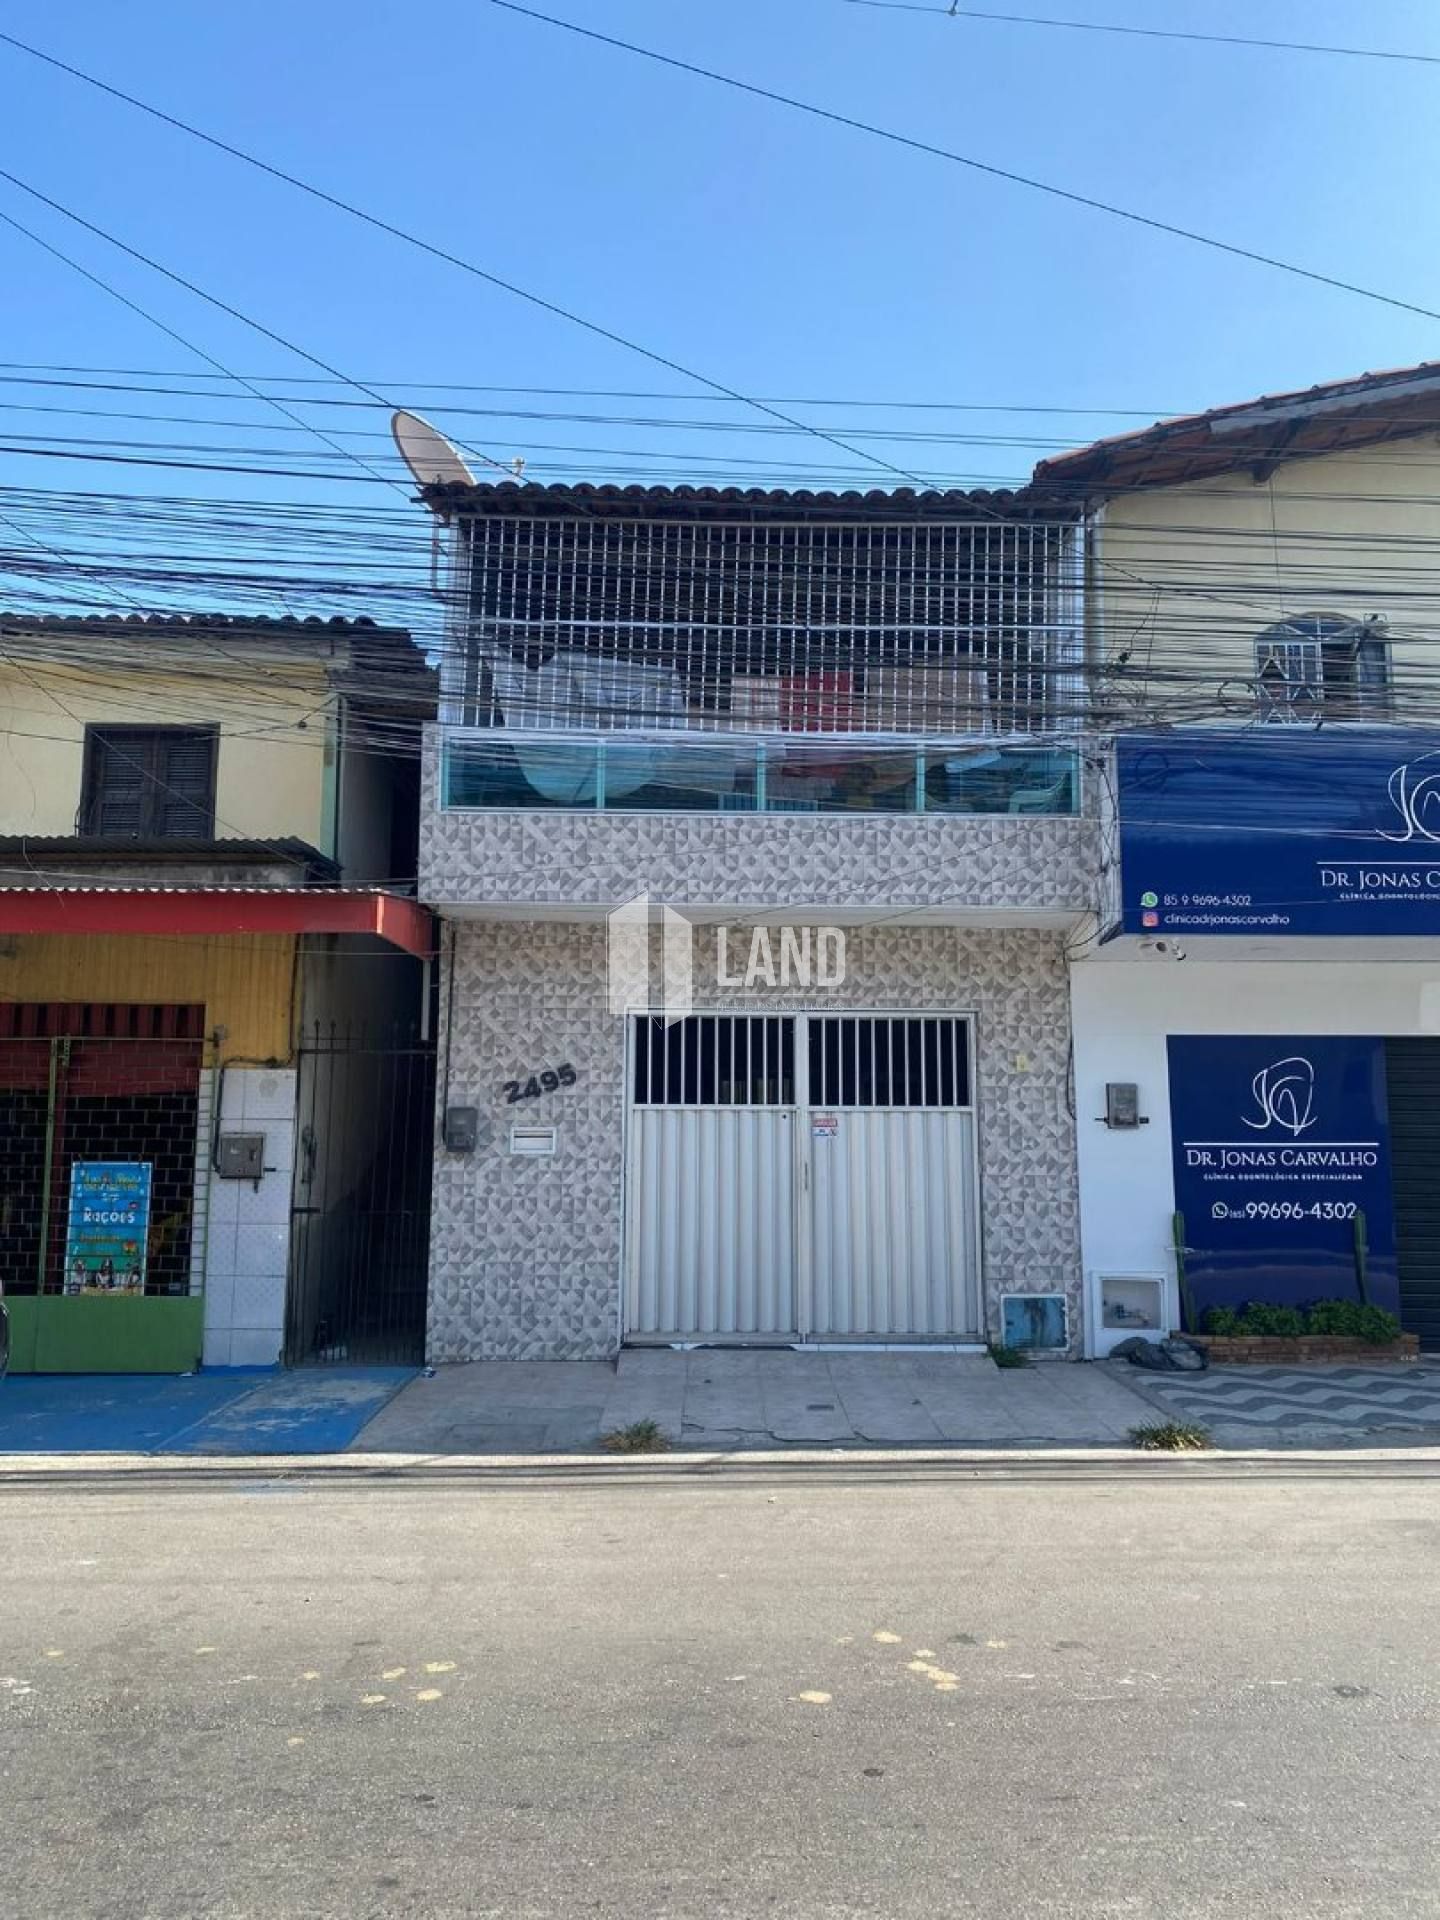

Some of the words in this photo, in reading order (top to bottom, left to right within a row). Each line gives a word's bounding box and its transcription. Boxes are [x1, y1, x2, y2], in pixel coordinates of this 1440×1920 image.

[1321, 870, 1354, 887] DR.
[1359, 870, 1422, 891] JONAS
[1163, 894, 1178, 906] 85
[1182, 894, 1190, 906] 9
[1192, 893, 1252, 907] 9696-4302
[502, 1062, 577, 1104] 2495
[1186, 1150, 1217, 1166] DR.
[1220, 1149, 1276, 1168] JONAS
[1280, 1149, 1377, 1166] CARVALHO
[1245, 1202, 1357, 1219] 99696-4302
